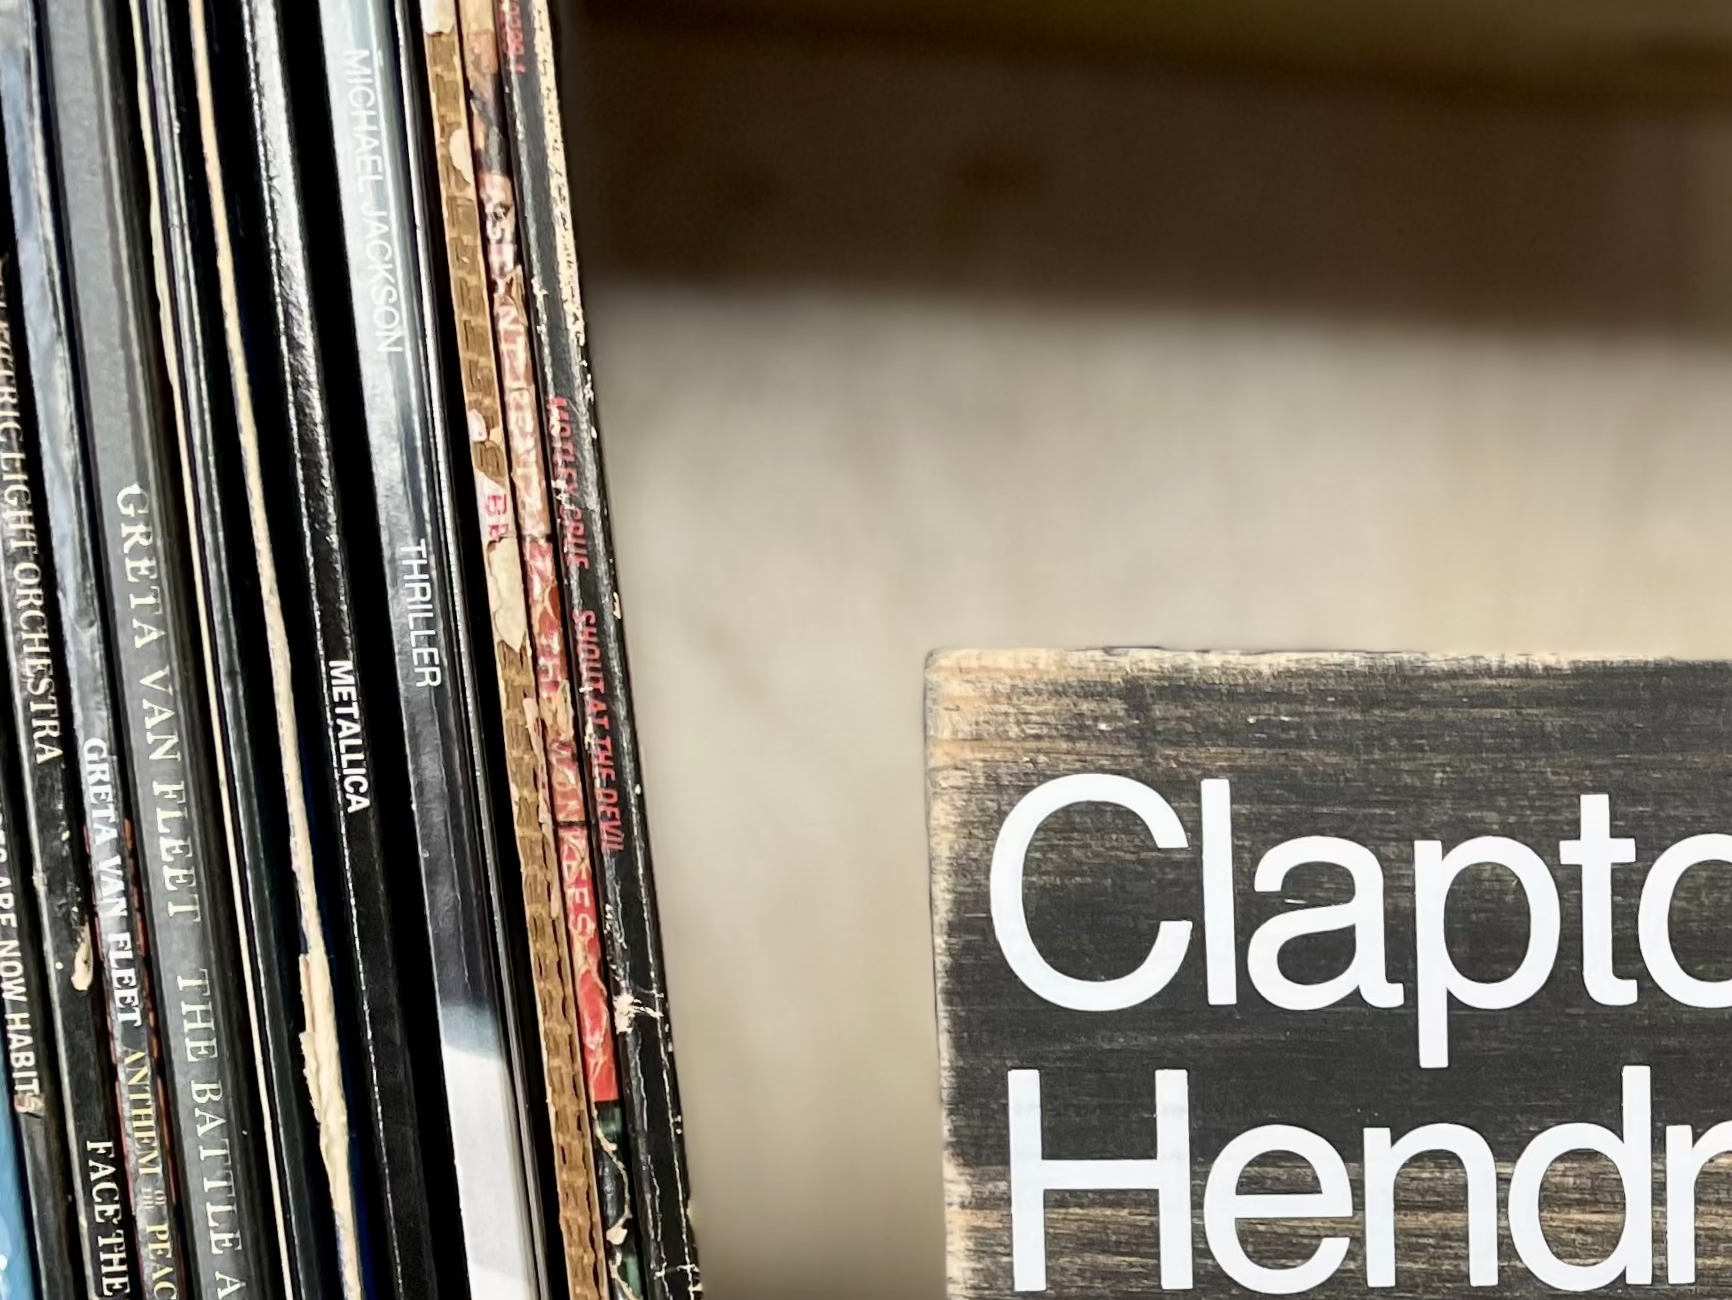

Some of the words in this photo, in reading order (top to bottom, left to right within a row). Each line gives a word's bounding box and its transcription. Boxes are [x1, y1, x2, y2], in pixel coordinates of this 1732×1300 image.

[343, 48, 385, 189] MICHAEL
[361, 193, 404, 354] JACKSON
[0, 451, 38, 555] LIGHT
[115, 482, 166, 650] GRETA
[400, 538, 442, 688] THRILLER
[14, 561, 64, 766] ORCHESTRA
[139, 665, 182, 762] VAN
[83, 736, 121, 848] GRETA
[328, 660, 371, 814] METALLICA
[152, 779, 201, 924] FLEET
[596, 790, 625, 852] DEVIL
[98, 854, 129, 918] VAN
[0, 939, 28, 1003] NOW
[106, 931, 142, 1028] FLEET
[176, 968, 219, 1063] THE
[122, 1048, 164, 1176] ANTHEM
[190, 1079, 243, 1256] BATTLE
[86, 1139, 121, 1225] FACE
[96, 1229, 131, 1297] THE
